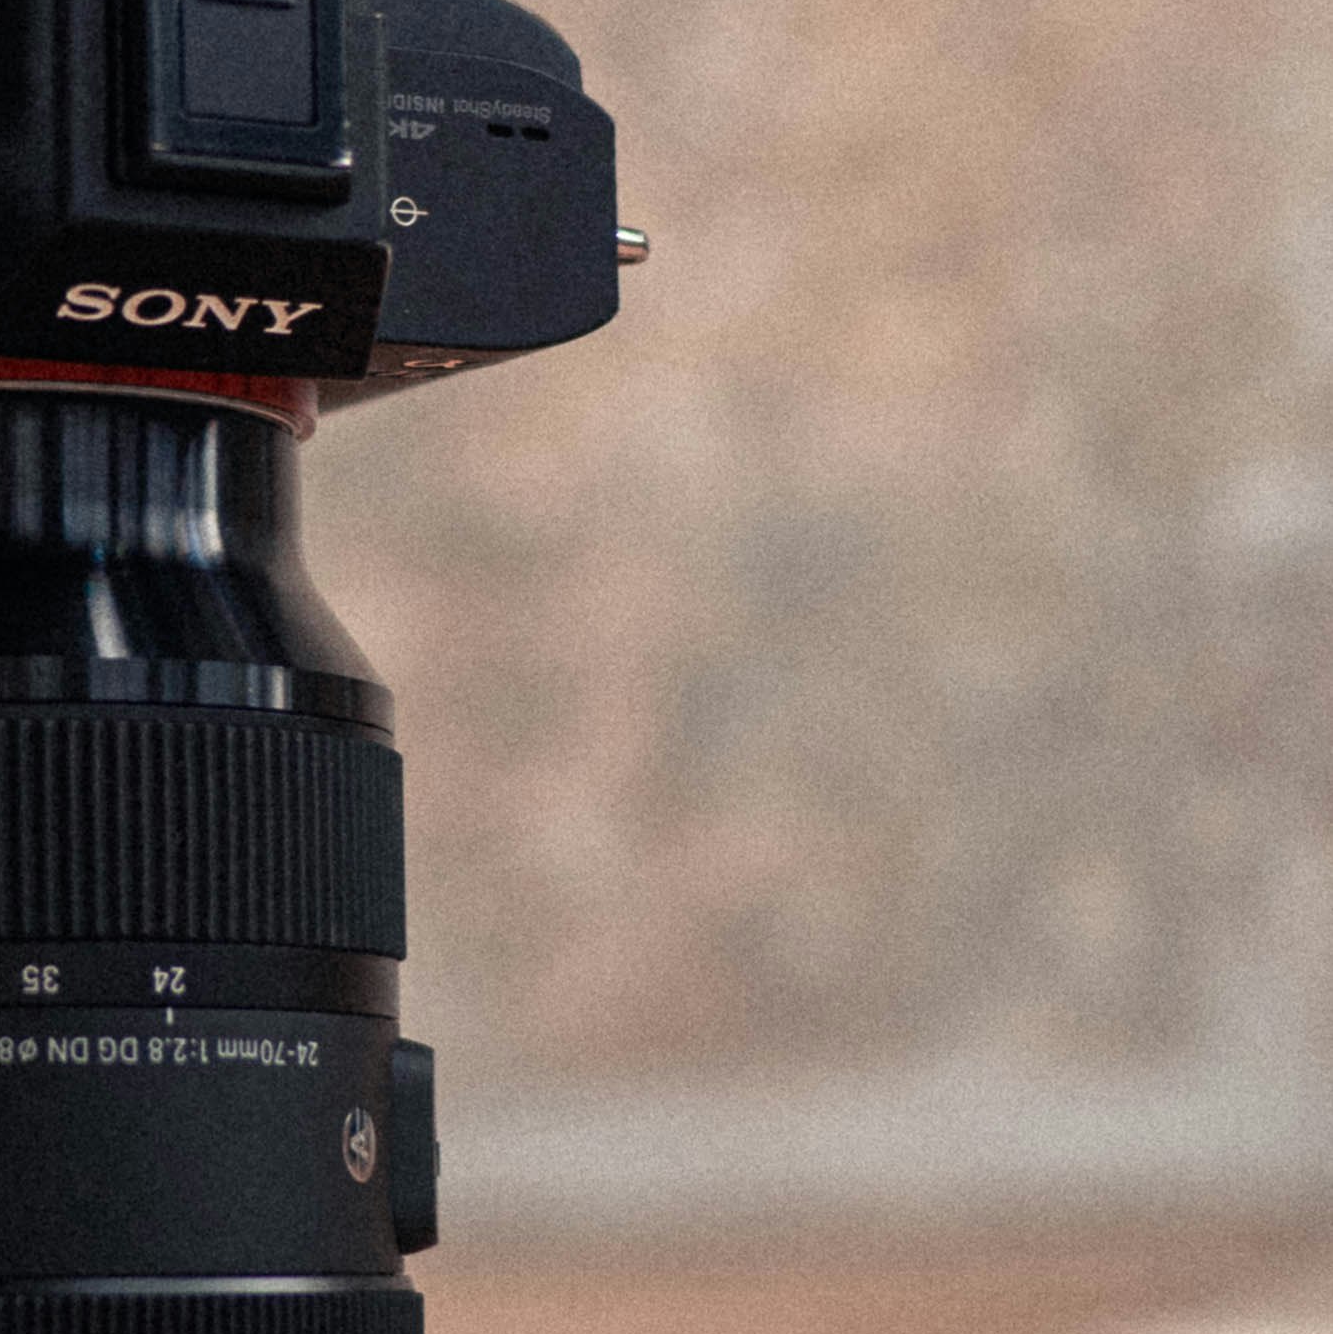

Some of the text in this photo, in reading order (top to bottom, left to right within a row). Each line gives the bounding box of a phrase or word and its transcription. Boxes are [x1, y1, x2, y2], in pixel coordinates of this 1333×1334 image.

[453, 98, 552, 125] SteadyShot
[388, 118, 437, 140] 4K
[55, 282, 324, 335] SONY
[21, 964, 60, 995] 35
[153, 966, 186, 995] 24
[46, 1035, 90, 1065] DN
[98, 1035, 139, 1065] DG
[148, 1035, 210, 1065] 1:2.8
[217, 1037, 319, 1067] 24-70mm
